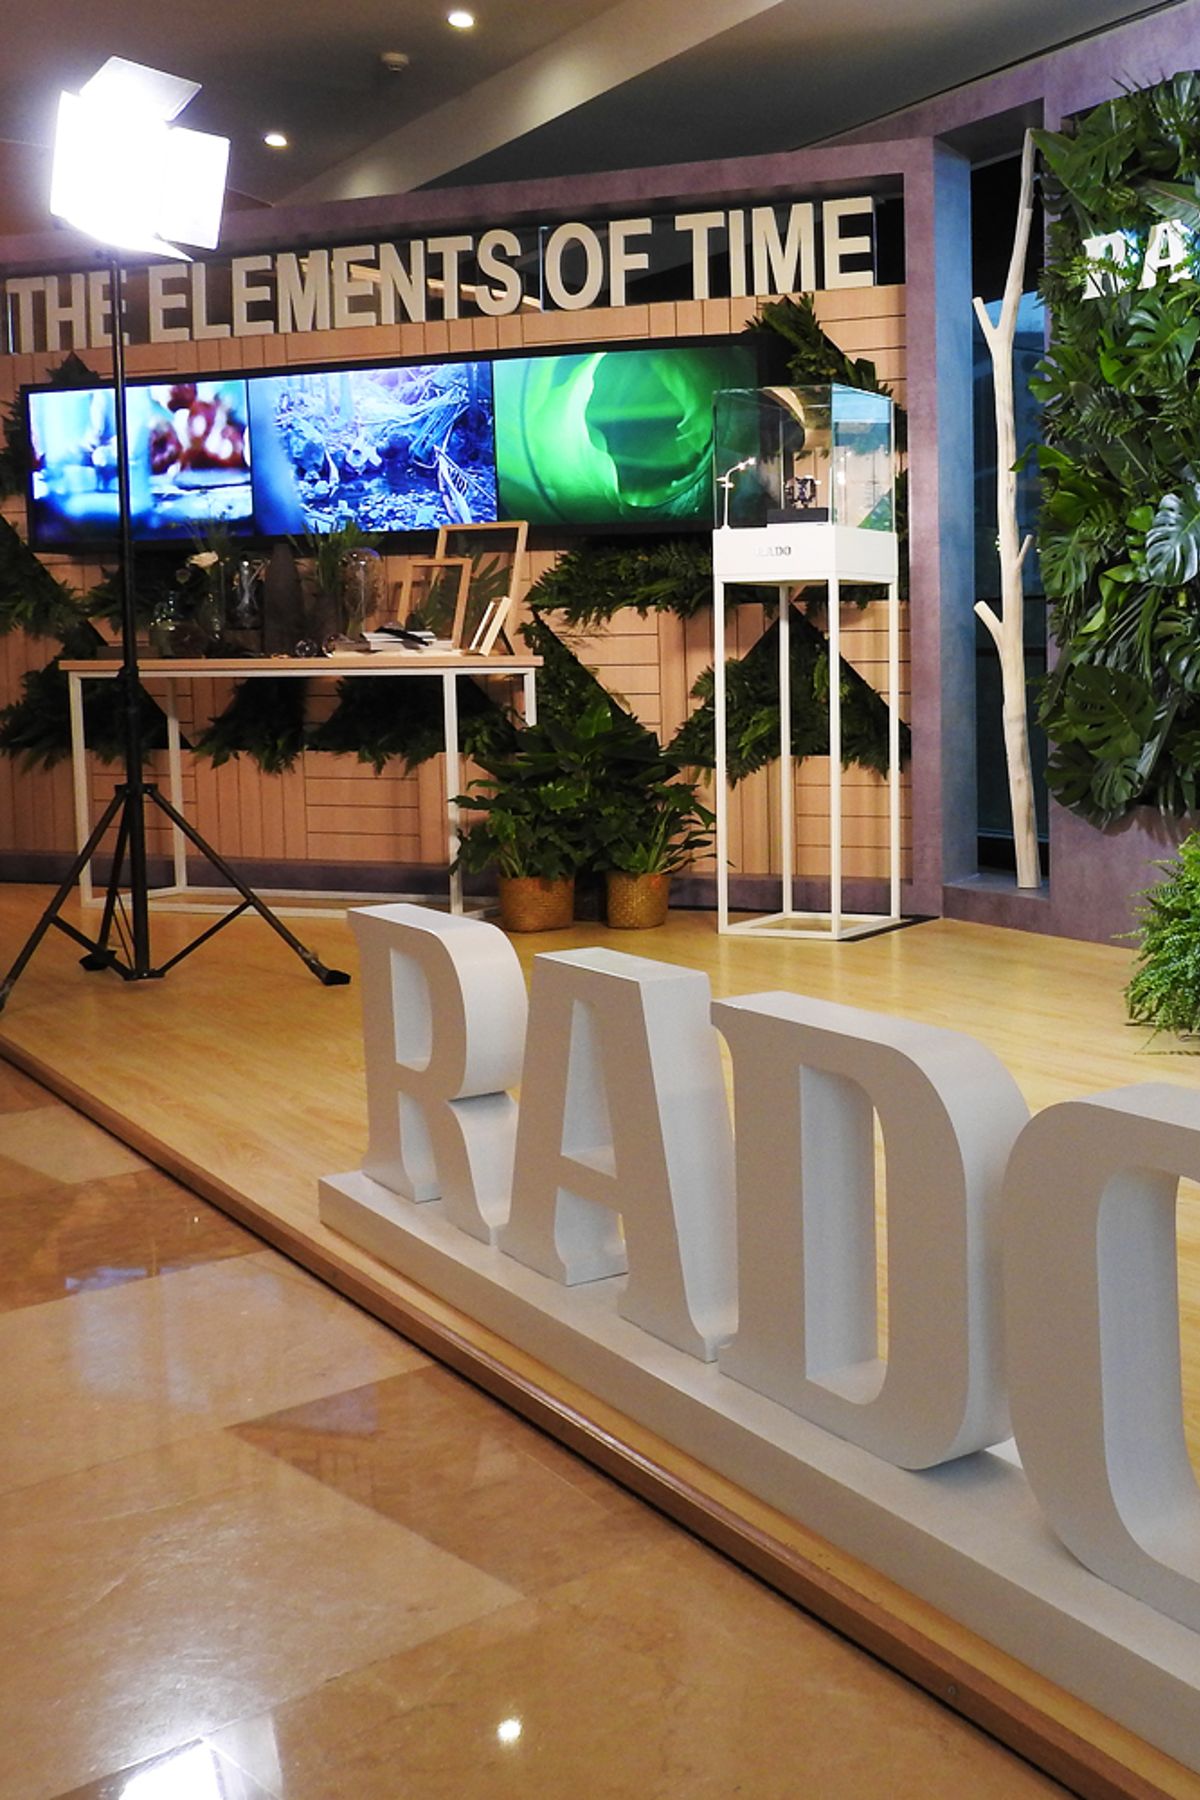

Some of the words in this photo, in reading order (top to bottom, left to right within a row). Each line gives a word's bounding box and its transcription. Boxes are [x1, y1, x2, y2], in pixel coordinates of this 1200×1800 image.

[6, 269, 130, 355] THE
[148, 228, 523, 343] ELEMENTS
[544, 217, 653, 312] OF
[674, 196, 875, 302] TIME
